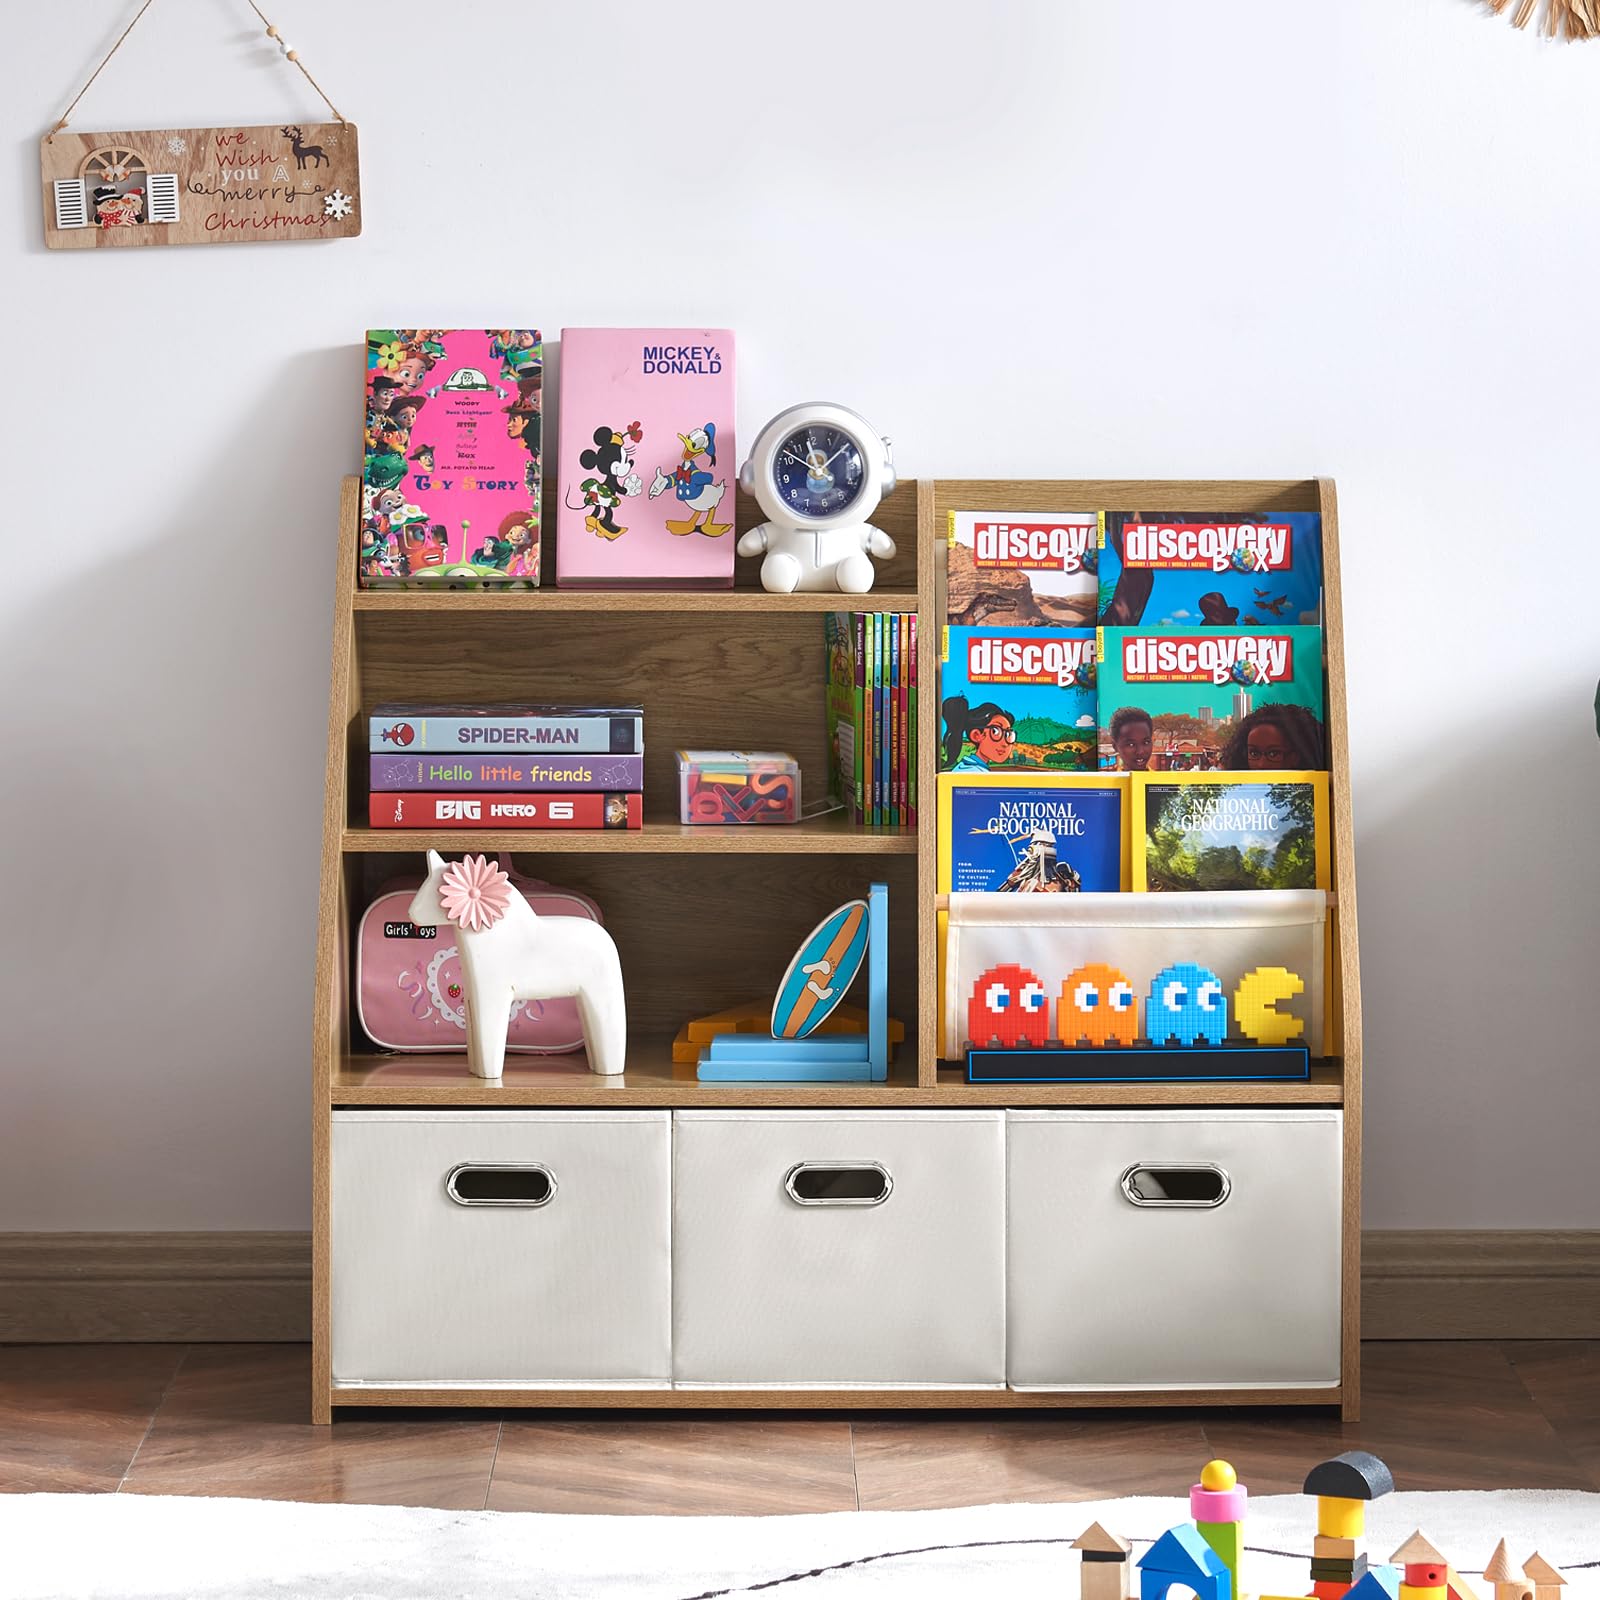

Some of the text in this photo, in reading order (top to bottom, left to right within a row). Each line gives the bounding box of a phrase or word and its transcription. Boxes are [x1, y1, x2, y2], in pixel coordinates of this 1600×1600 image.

[216, 132, 249, 147] we
[216, 149, 279, 167] Wish
[221, 164, 290, 186] you A
[205, 211, 331, 231] Christmas
[643, 360, 722, 374] DONALD
[784, 457, 794, 465] 10
[783, 474, 790, 484] 9
[790, 489, 798, 498] 8
[804, 499, 810, 507] 7
[821, 499, 828, 507] 6
[1126, 524, 1287, 564] discovery
[1126, 636, 1287, 676] discovery
[457, 727, 579, 744] SPIDER-MAN
[429, 765, 593, 782] Hello little friends
[394, 799, 404, 823] Disney
[435, 800, 574, 820] BIG HERO 6
[1000, 801, 1076, 818] NATIONAL
[1192, 798, 1270, 814] NATIONAL
[987, 818, 1085, 836] GEOGRAPHIC
[1180, 814, 1279, 832] GEOGRAPHIC
[386, 923, 413, 936] Girls'
